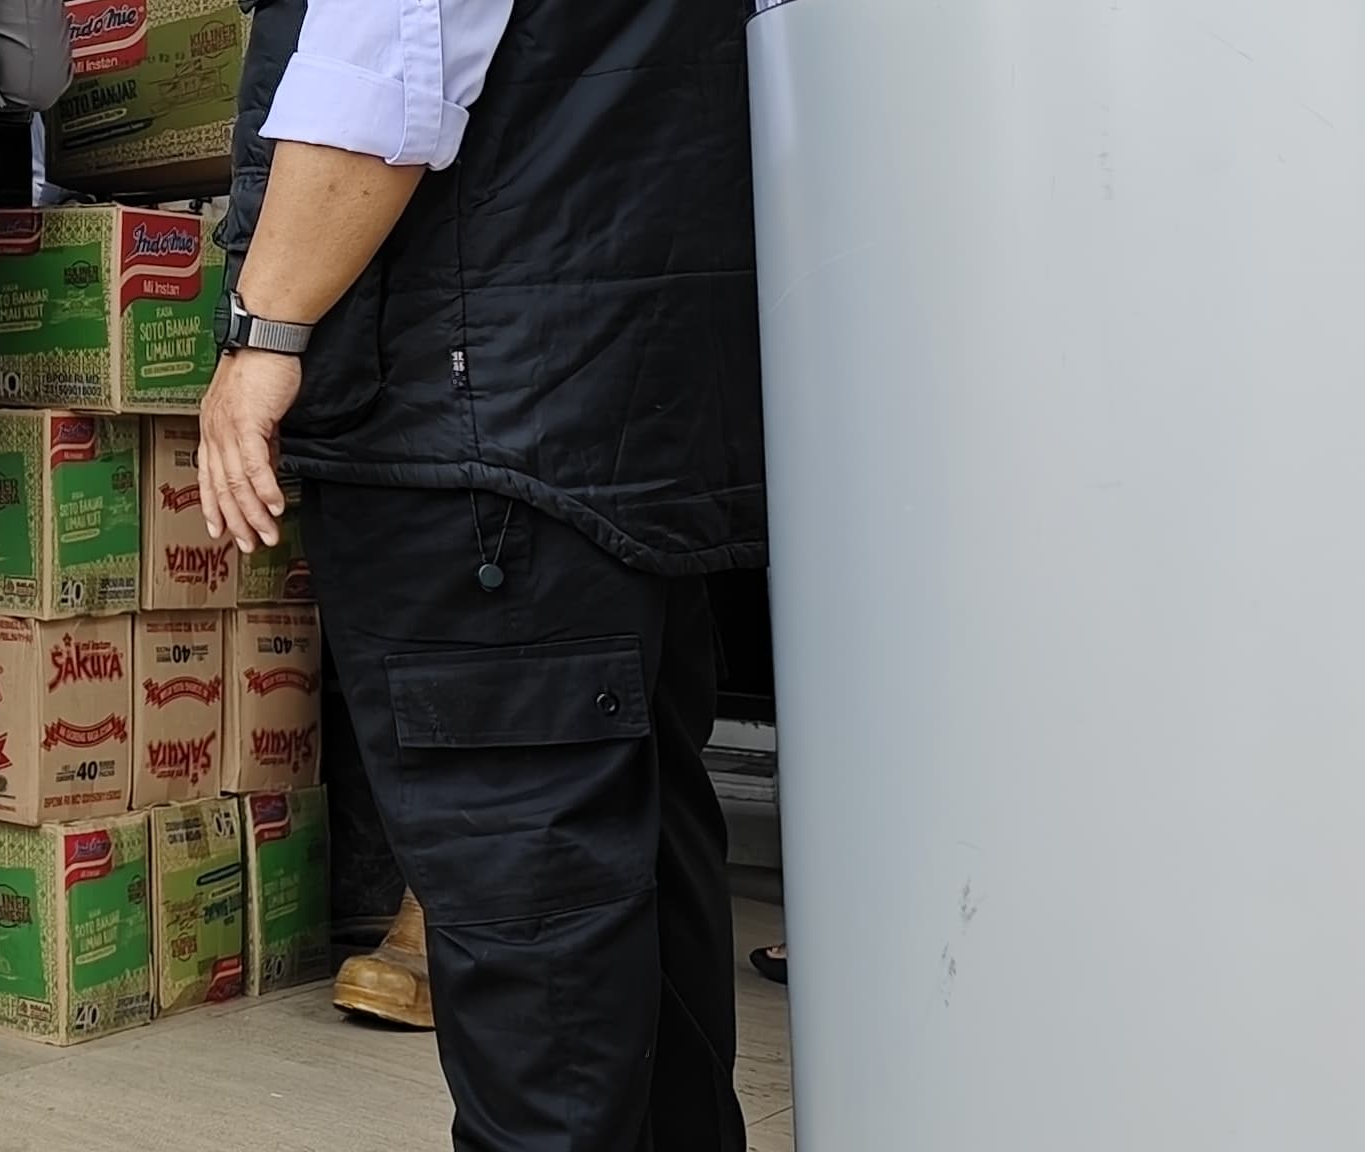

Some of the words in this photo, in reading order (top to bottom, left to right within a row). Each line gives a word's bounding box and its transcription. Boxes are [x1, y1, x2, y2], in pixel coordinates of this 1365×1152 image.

[140, 323, 163, 340] SOTO
[166, 317, 201, 337] BANJAR
[176, 338, 196, 355] KUIT
[62, 580, 84, 606] 40
[173, 645, 190, 663] 40
[274, 636, 292, 654] 40
[76, 761, 98, 780] 40
[75, 1003, 99, 1030] 40
